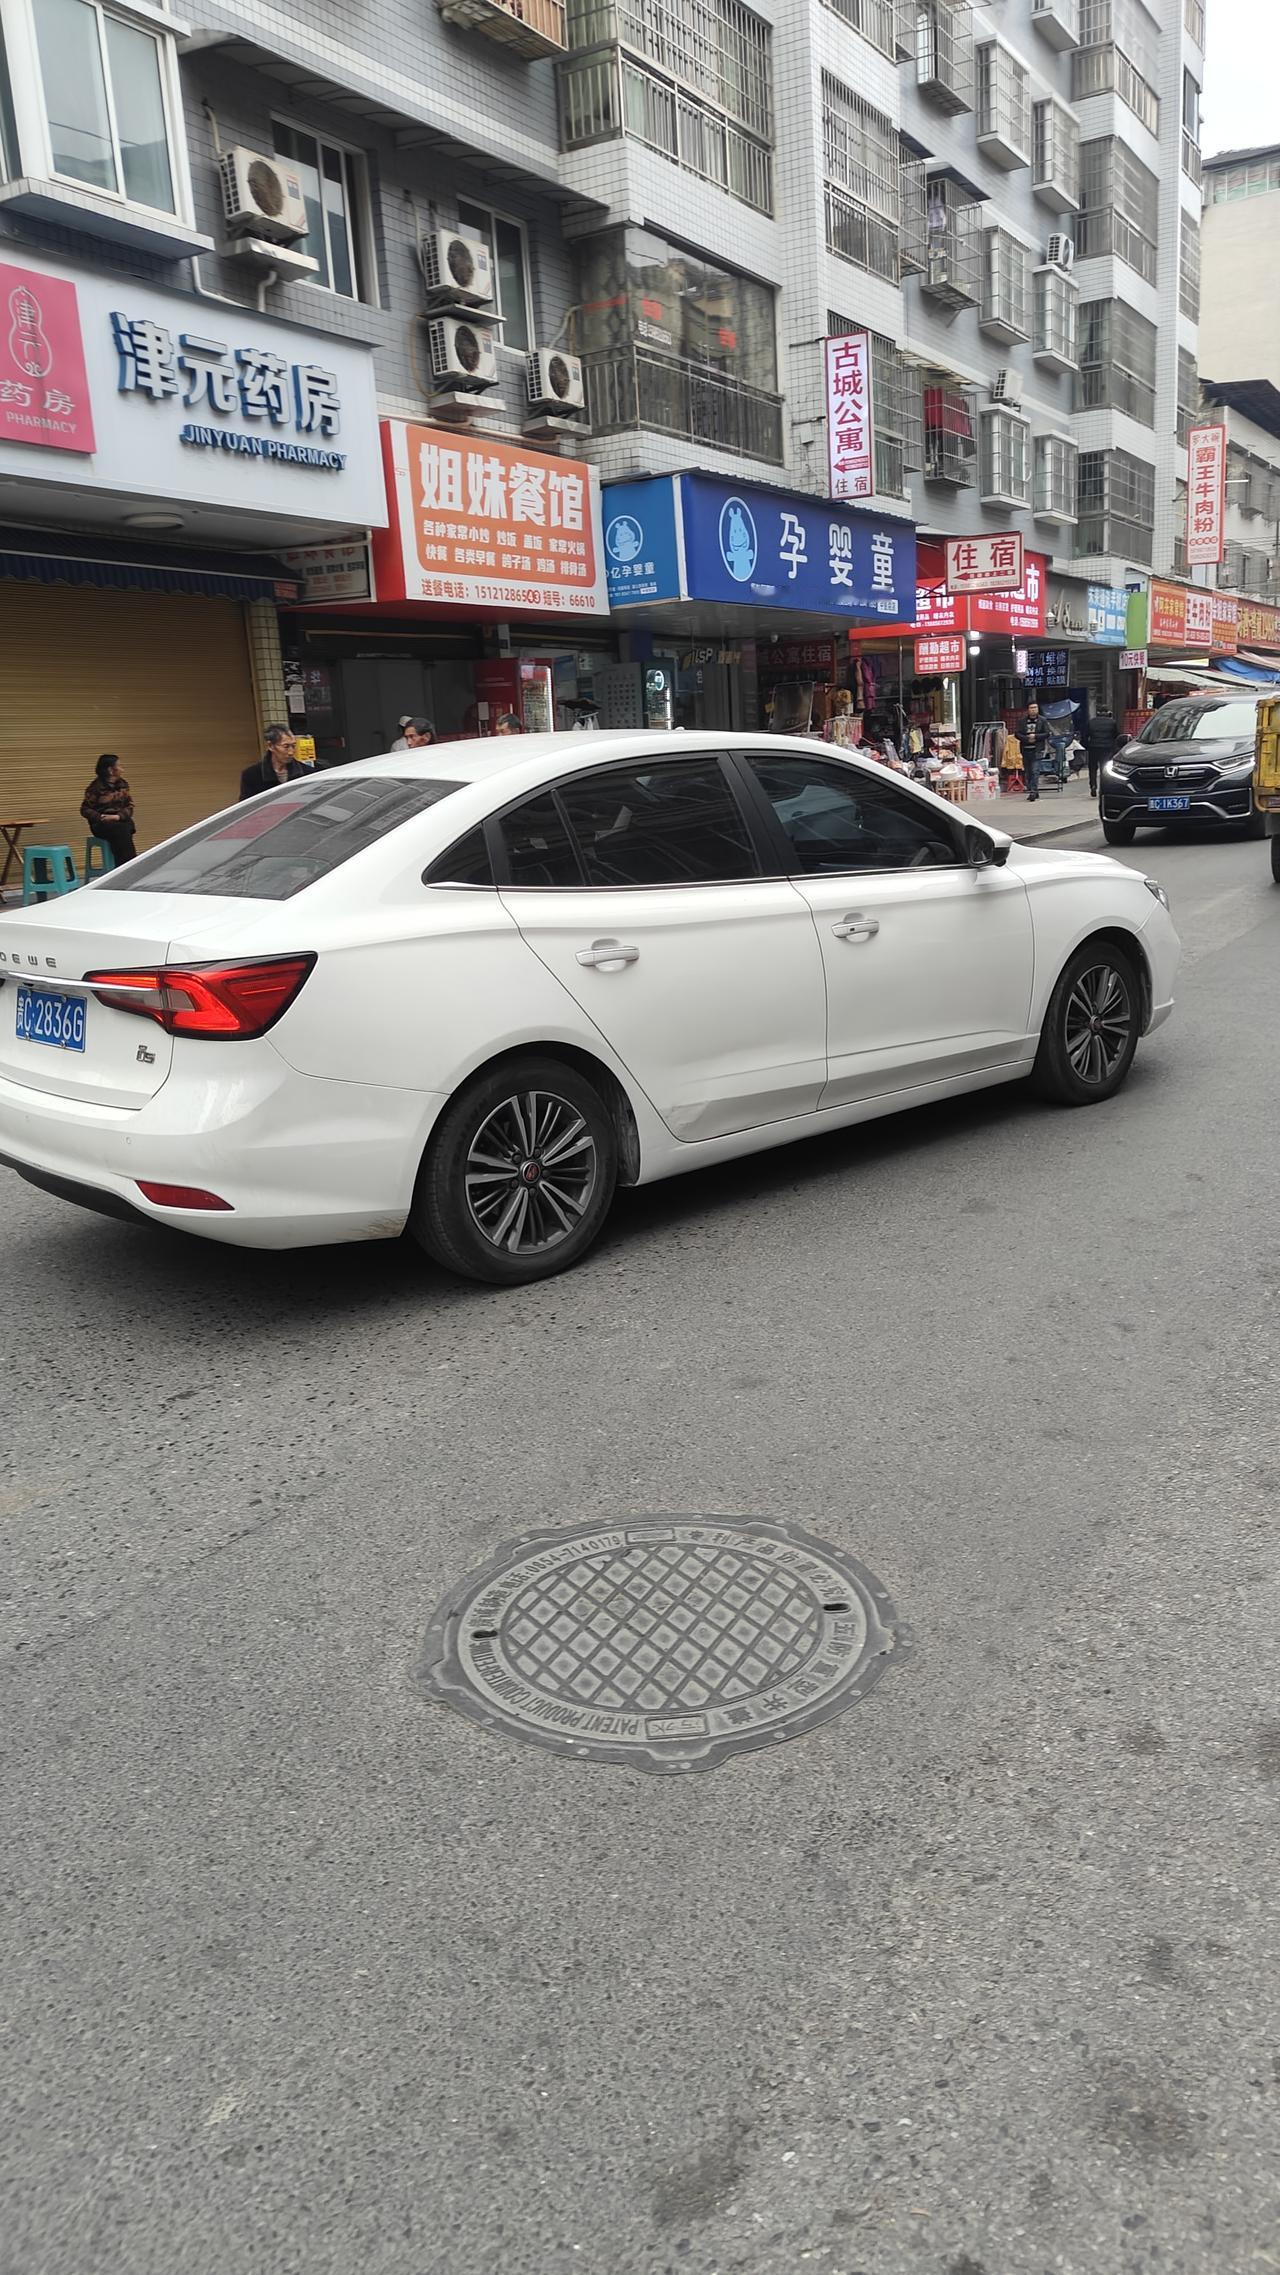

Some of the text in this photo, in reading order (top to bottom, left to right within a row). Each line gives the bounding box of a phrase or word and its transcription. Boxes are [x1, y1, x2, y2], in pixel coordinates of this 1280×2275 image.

[110, 311, 341, 436] 津元药房
[0, 379, 76, 416] 药房
[832, 341, 864, 454] 古城公寓
[6, 411, 77, 434] PHARMACY
[180, 424, 348, 471] JINYUAN PHARMACY
[418, 442, 584, 531] 姐妹餐馆
[834, 475, 868, 494] 住宿
[1193, 446, 1216, 534] 霸王牛肉粉
[423, 519, 490, 544] 各种家常小炒
[425, 544, 448, 561] 快餐
[454, 547, 496, 567] 各类早餐
[952, 540, 1016, 572] 住宿
[569, 594, 595, 608] 66610
[468, 1641, 640, 1736] PATENT PRODUCT COUNTERFEITING
